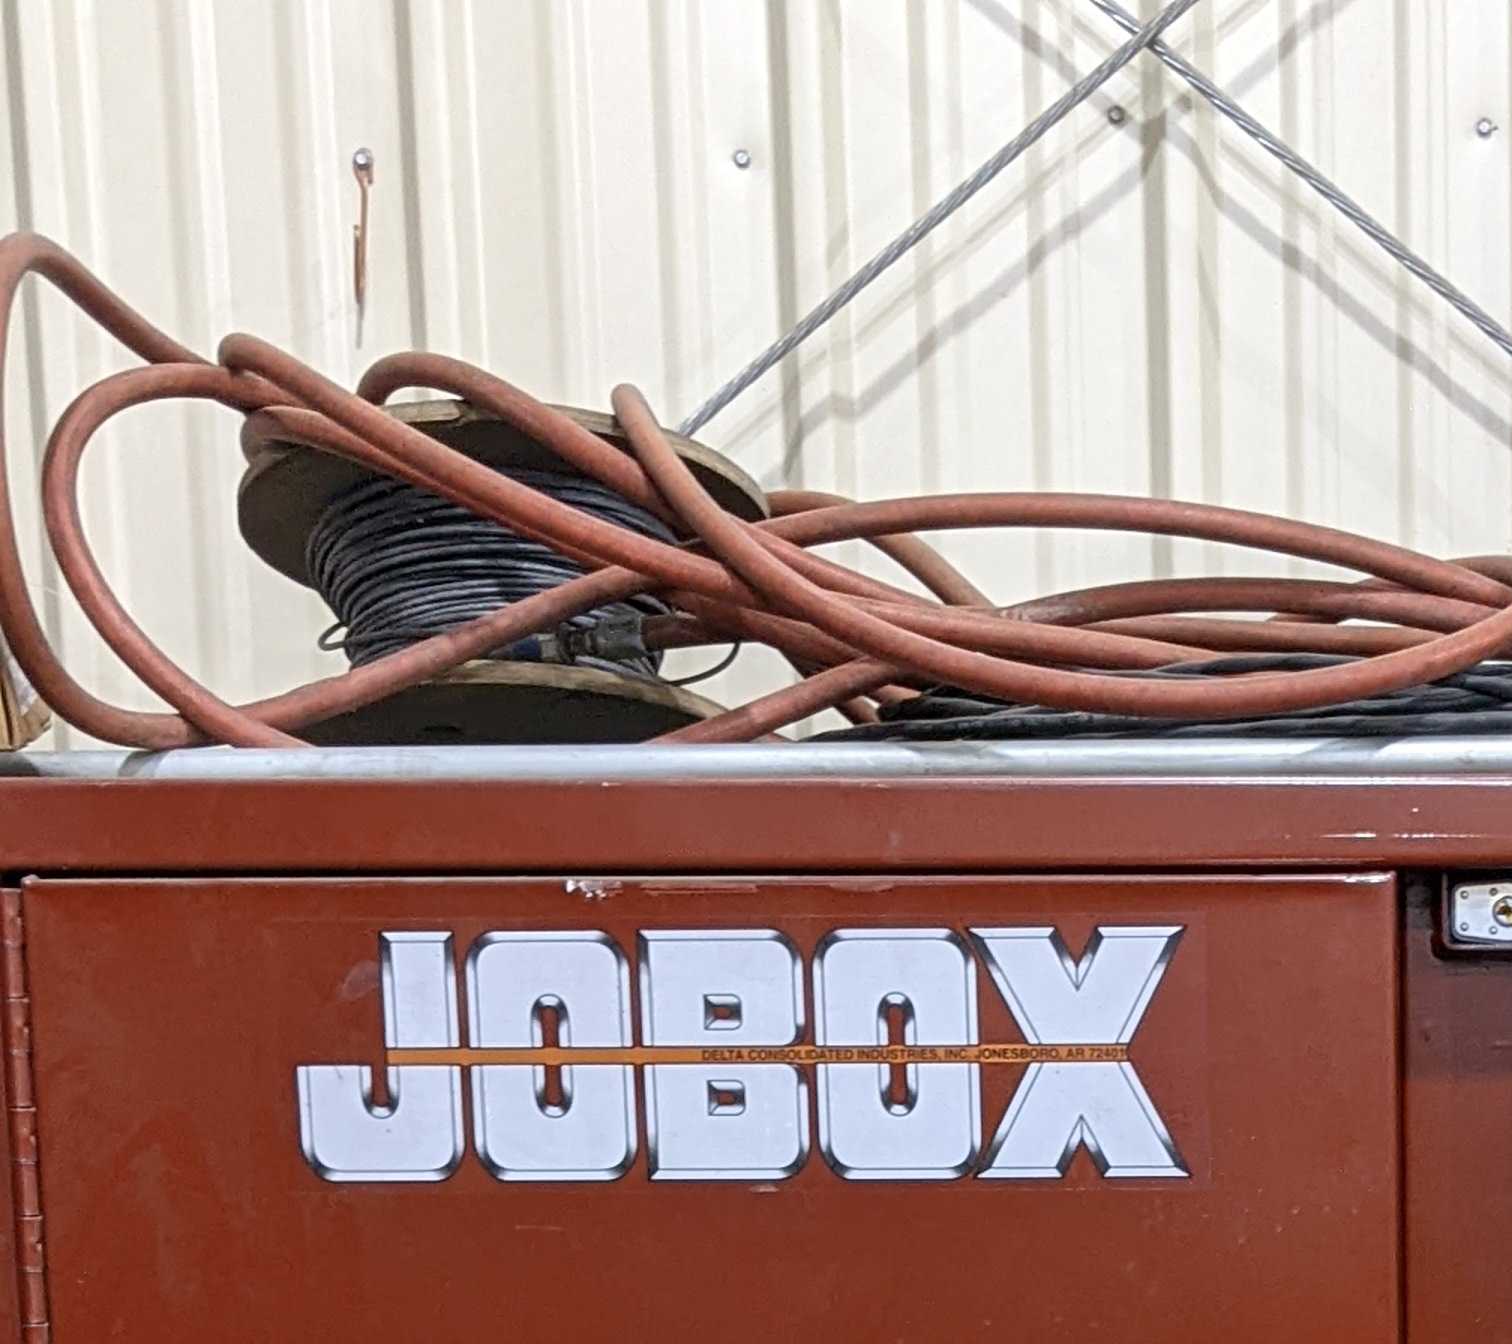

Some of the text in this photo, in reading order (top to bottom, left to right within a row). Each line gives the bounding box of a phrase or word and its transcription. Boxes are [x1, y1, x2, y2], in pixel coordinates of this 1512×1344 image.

[296, 925, 1193, 1183] JOBOX
[702, 1049, 742, 1061] DELTA
[747, 1049, 854, 1061] CONSOLIDATED
[1066, 1047, 1085, 1059] AR
